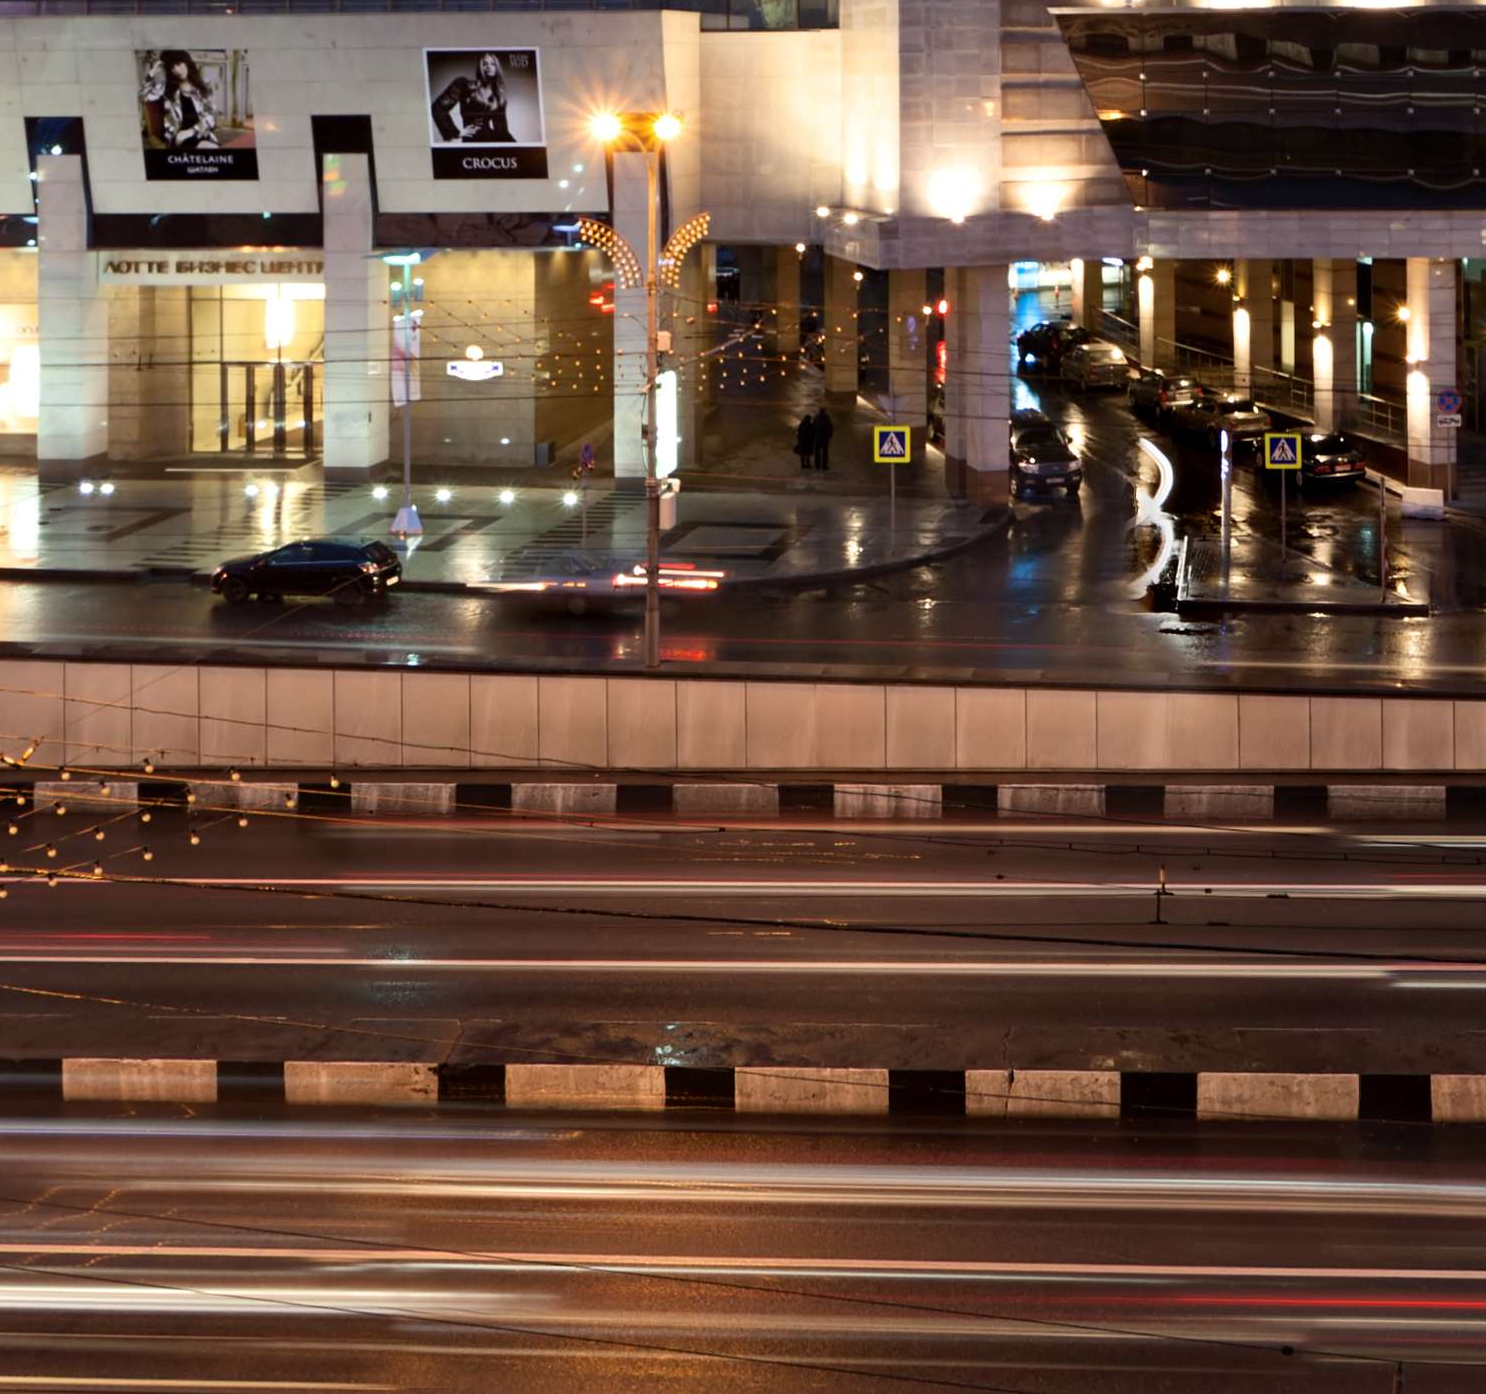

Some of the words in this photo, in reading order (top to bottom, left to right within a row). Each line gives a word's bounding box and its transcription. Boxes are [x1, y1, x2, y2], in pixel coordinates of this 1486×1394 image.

[462, 157, 518, 169] CROCUS
[104, 260, 169, 274] ЛОТТЕ
[175, 260, 257, 274] БИЗНЕС
